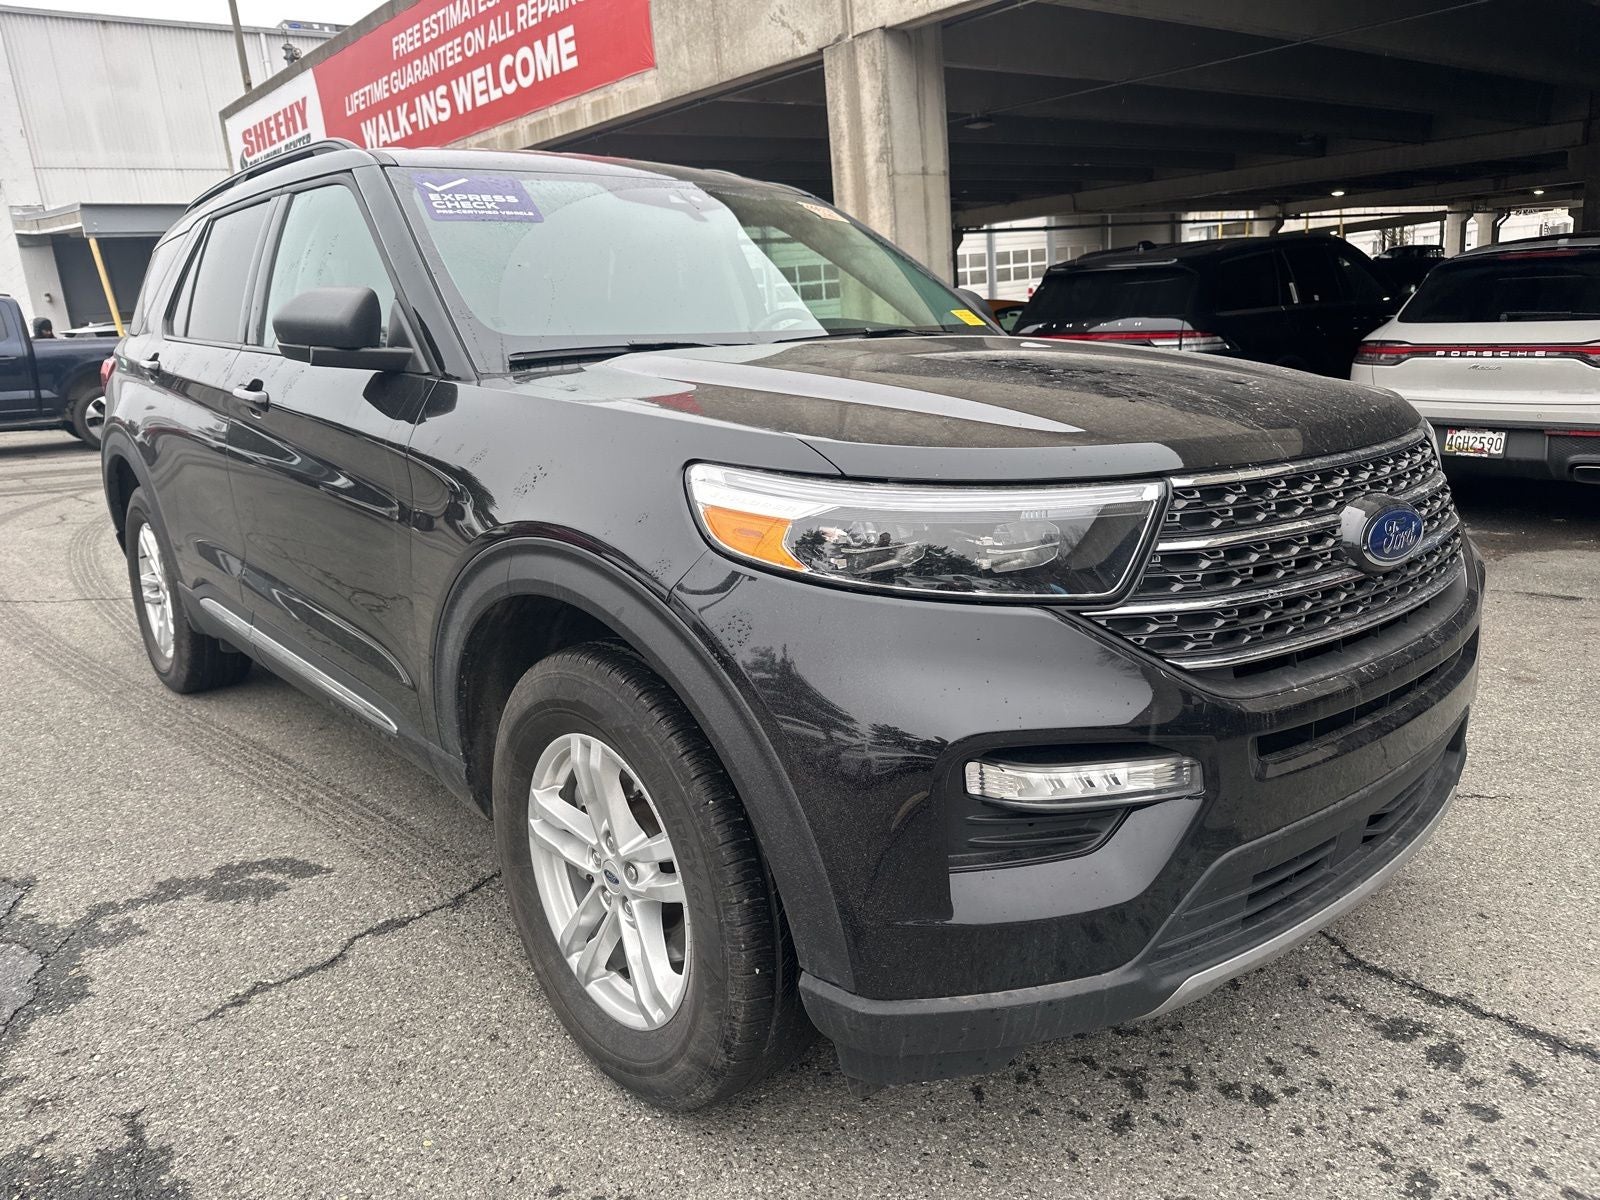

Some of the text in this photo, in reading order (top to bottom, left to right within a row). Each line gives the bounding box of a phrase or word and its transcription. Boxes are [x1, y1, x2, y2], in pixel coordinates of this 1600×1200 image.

[345, 0, 584, 117] LIFETIME GUARANTEE ON ALL REPA
[391, 23, 421, 60] FREE
[360, 24, 579, 150] WALK-INS WELCOME
[242, 95, 309, 158] SHEEHY
[428, 193, 519, 202] EXPRESS
[432, 201, 501, 210] CHECK
[1446, 434, 1504, 453] 4GH2590
[1383, 517, 1417, 555] Ford
